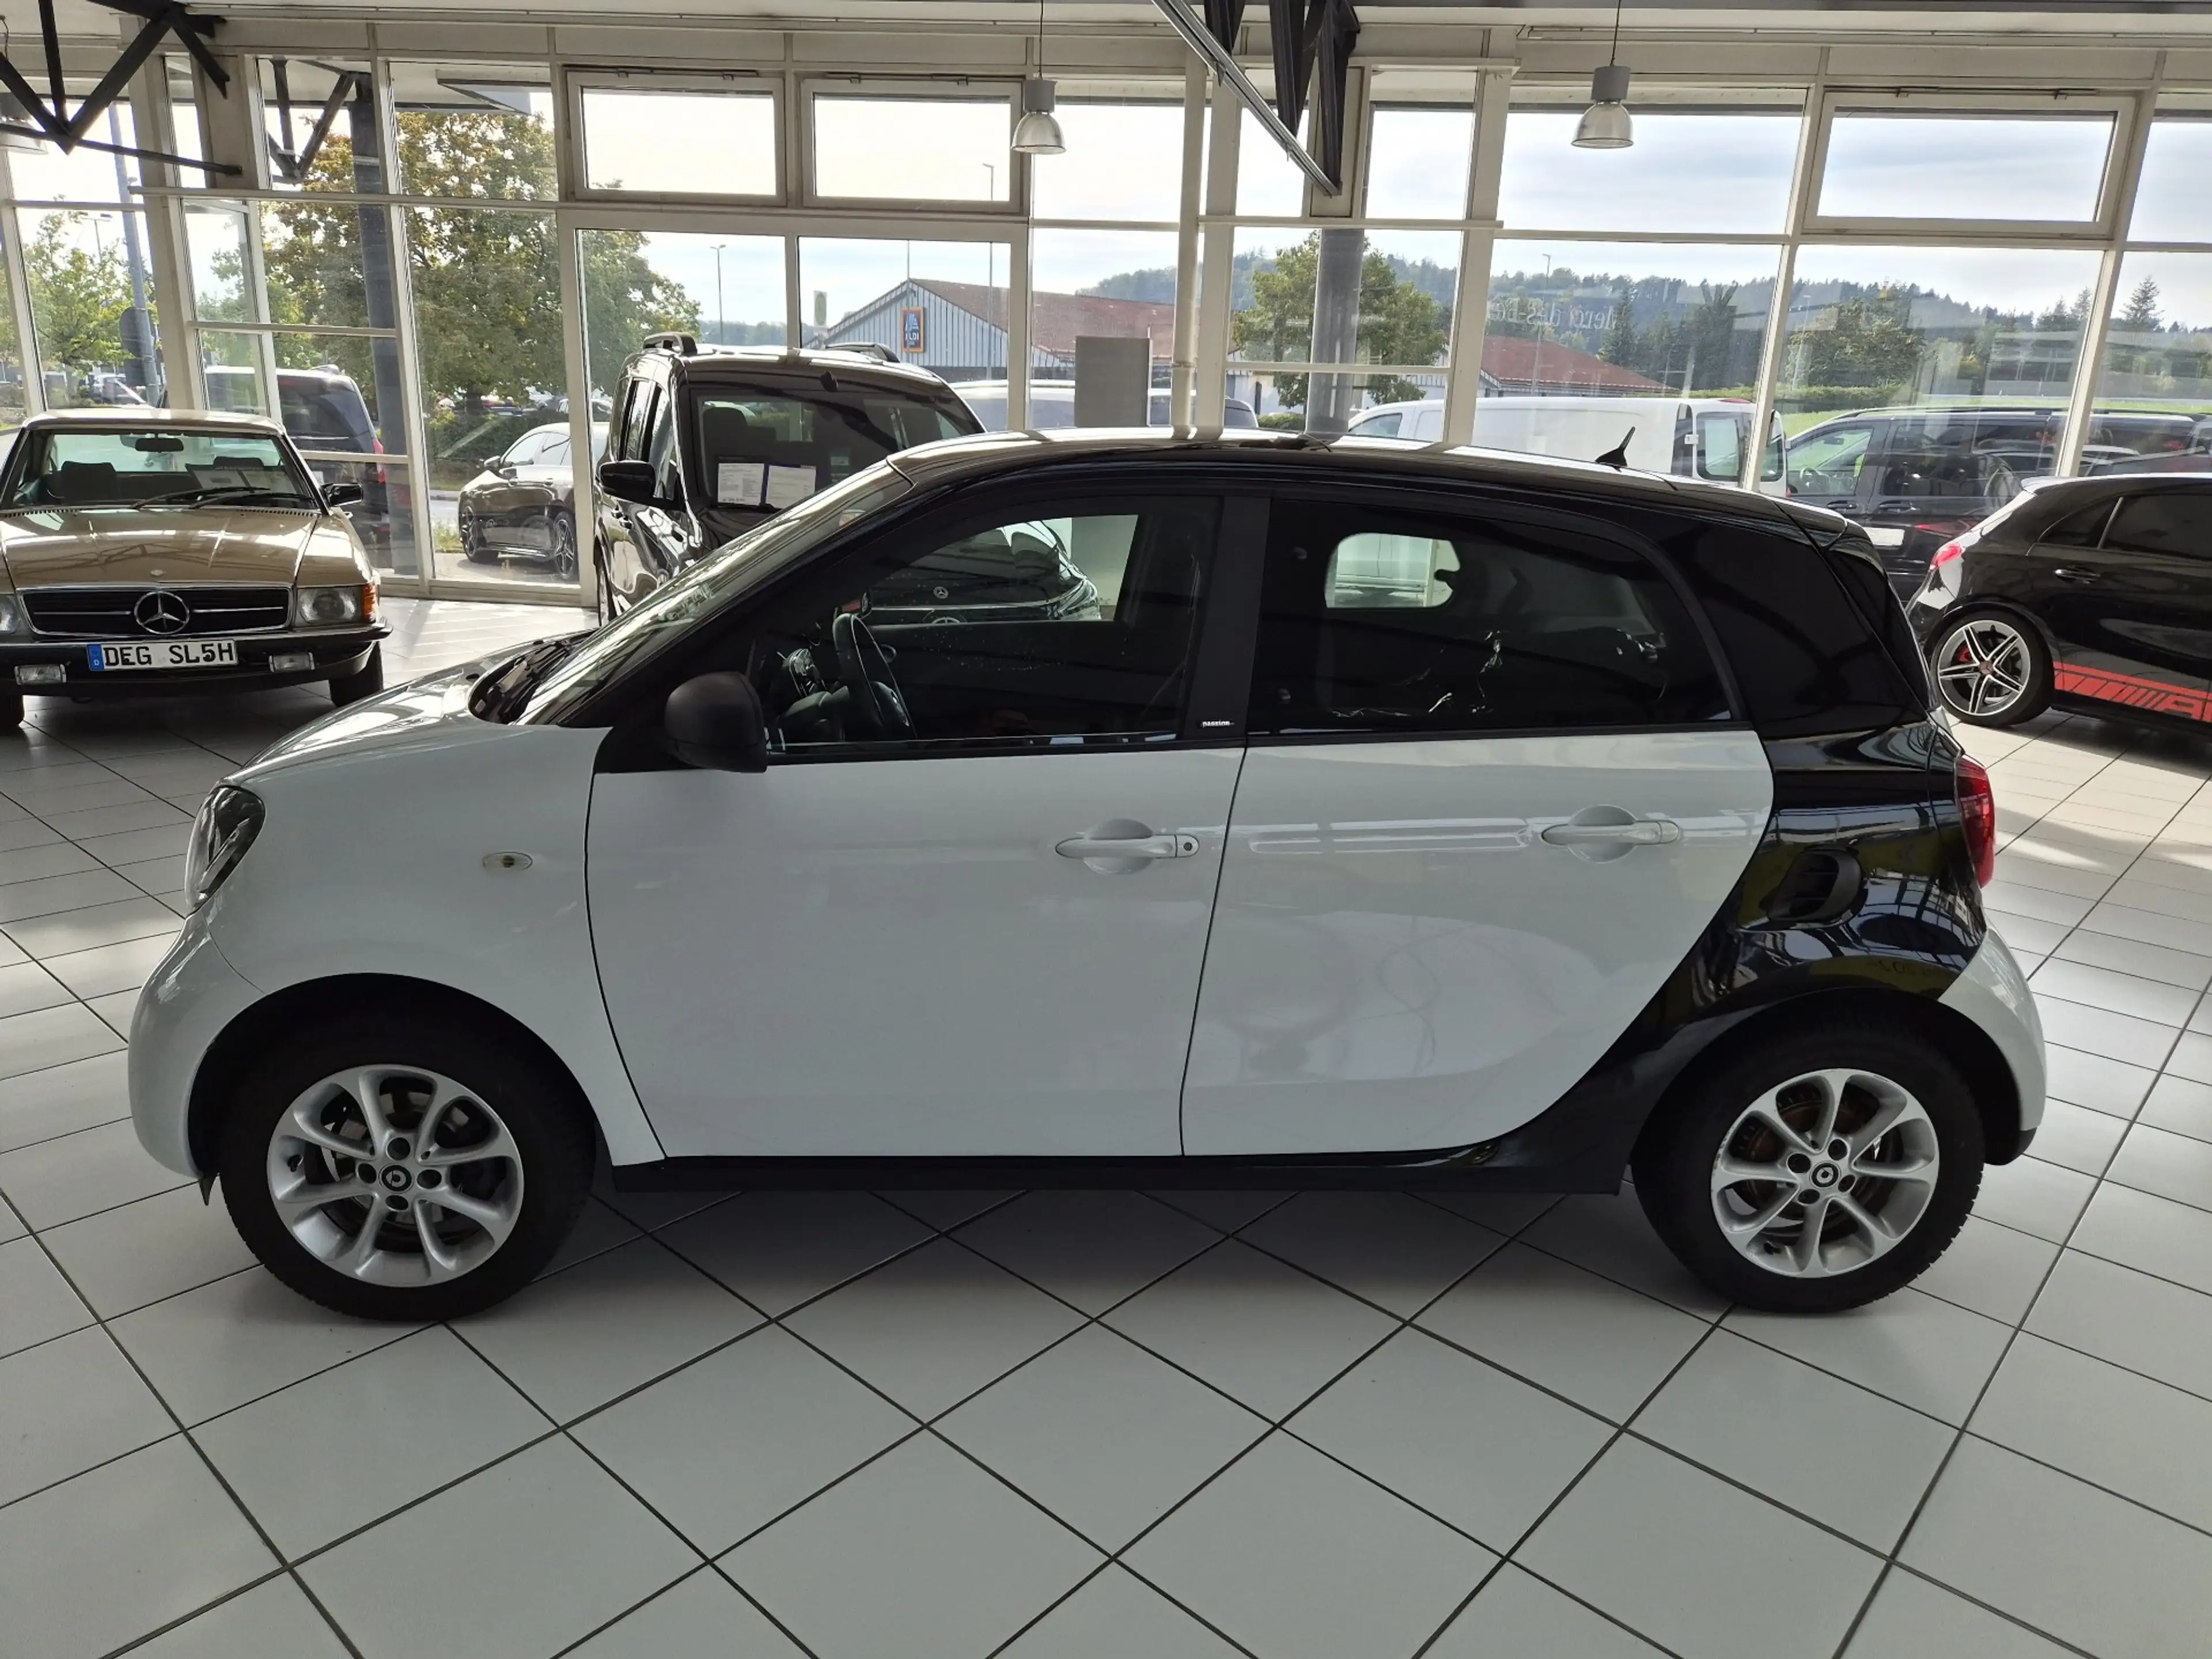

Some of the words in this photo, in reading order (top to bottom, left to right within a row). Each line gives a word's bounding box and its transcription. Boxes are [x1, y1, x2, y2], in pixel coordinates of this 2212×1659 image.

[103, 646, 153, 666] DEG
[169, 642, 234, 664] SL5H
[1202, 719, 1230, 728] passion
